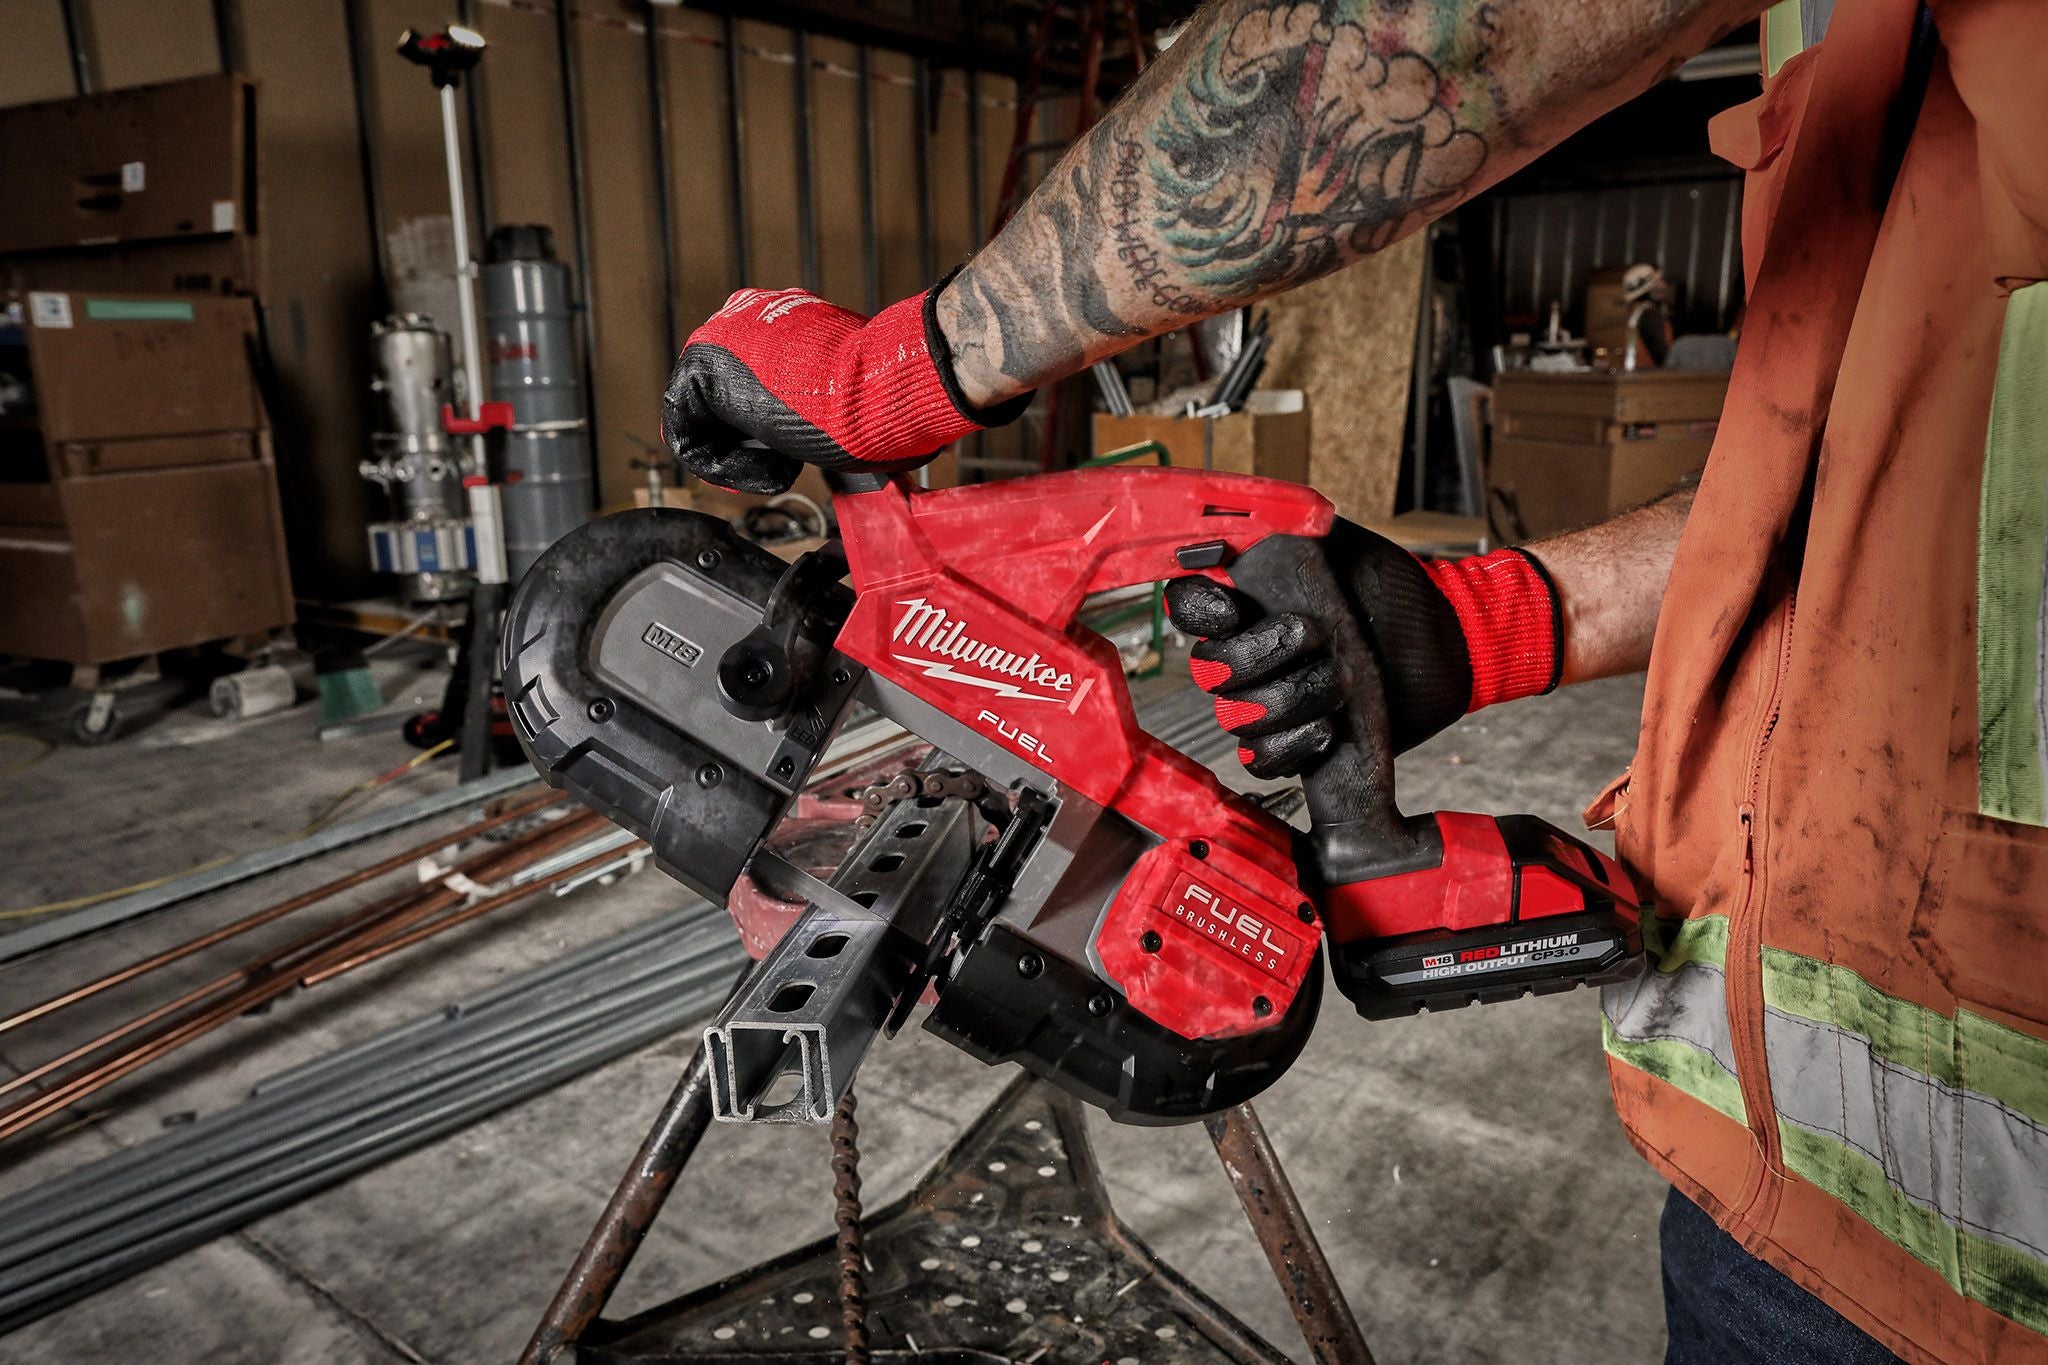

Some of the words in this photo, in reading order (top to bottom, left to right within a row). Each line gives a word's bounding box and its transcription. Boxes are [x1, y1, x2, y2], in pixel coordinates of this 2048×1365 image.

[647, 625, 701, 664] M18
[892, 597, 1073, 692] Milwaukee
[976, 709, 1054, 764] FUEL
[1175, 904, 1277, 970] BRUSHLESS
[1183, 884, 1285, 956] FUEL
[1422, 965, 1462, 980] HIGH
[1465, 954, 1528, 973] OUTPUT
[1531, 945, 1580, 962] CP3.0
[1424, 955, 1452, 968] M18
[1459, 933, 1578, 963] REDLITHIUM
